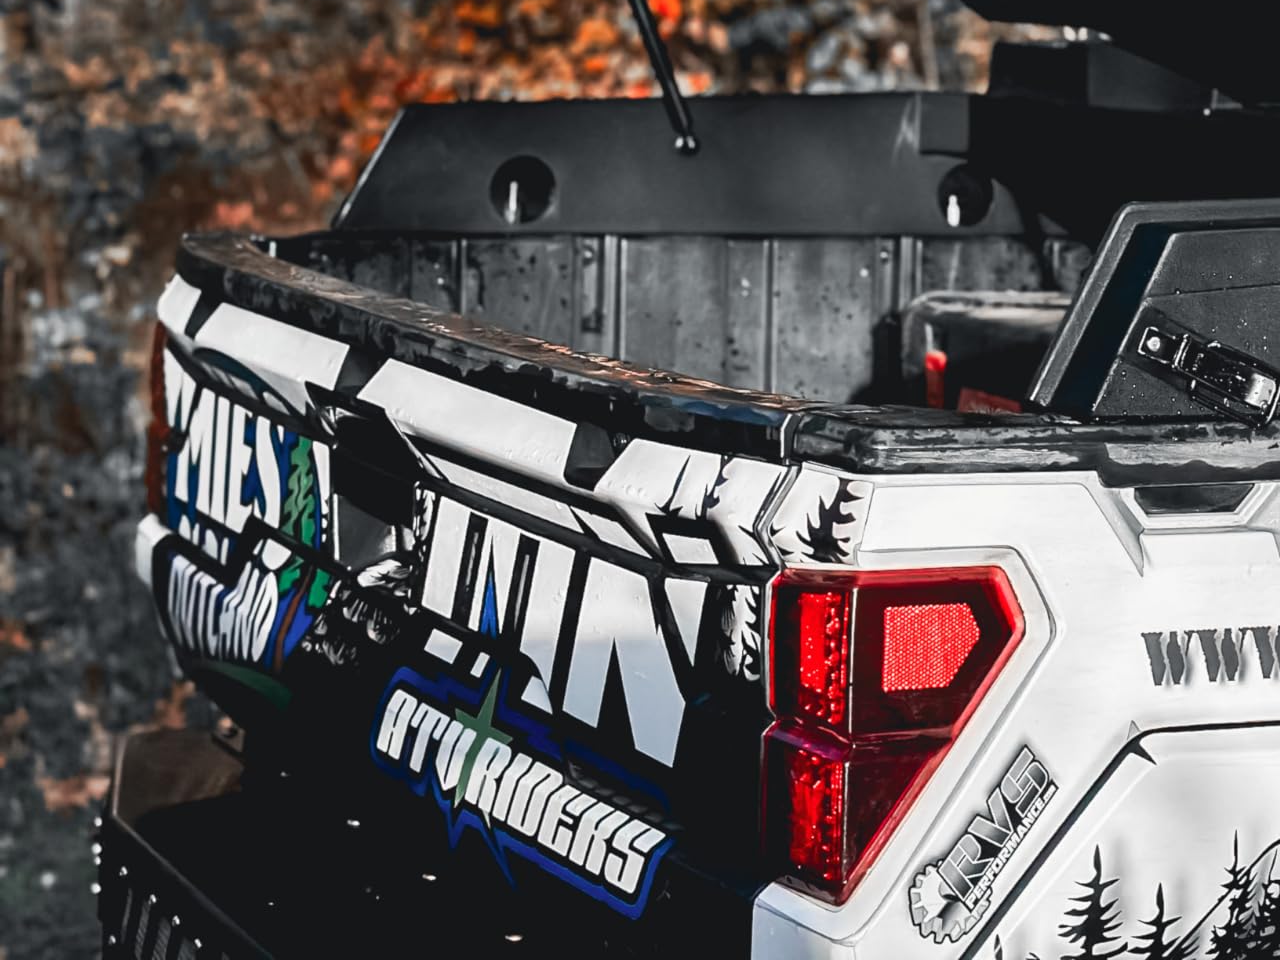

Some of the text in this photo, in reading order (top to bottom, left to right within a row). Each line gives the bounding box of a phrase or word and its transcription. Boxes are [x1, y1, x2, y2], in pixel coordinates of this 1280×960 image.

[376, 689, 666, 895] ATV RIDERS
[938, 745, 1050, 903] RVS
